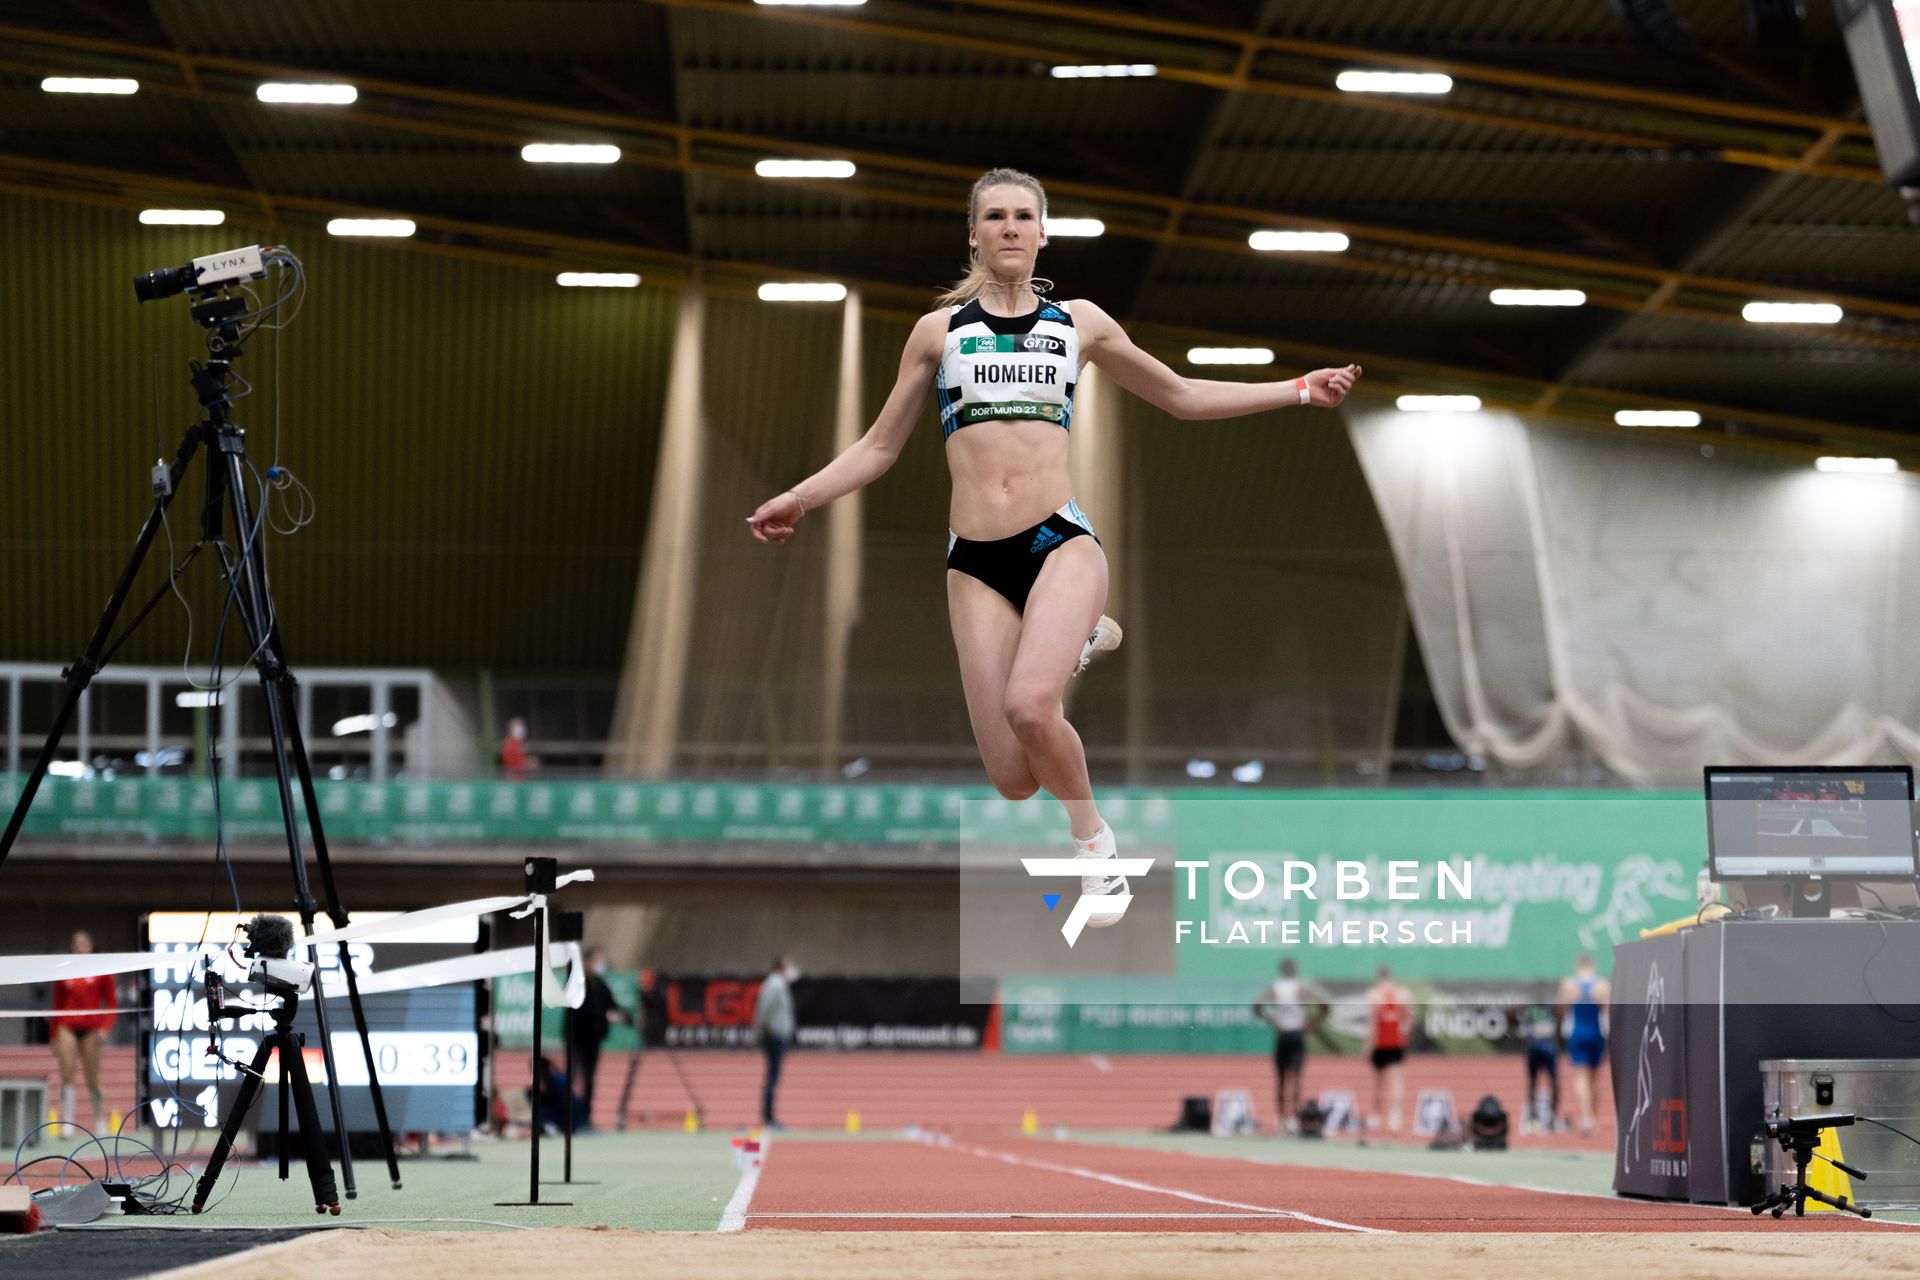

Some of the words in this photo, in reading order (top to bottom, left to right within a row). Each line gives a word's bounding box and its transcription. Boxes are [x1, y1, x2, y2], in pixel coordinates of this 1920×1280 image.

[212, 256, 246, 271] LYNX
[974, 364, 1057, 385] HOMEIER
[971, 406, 1024, 417] DORTMUND
[1030, 533, 1063, 553] adidas
